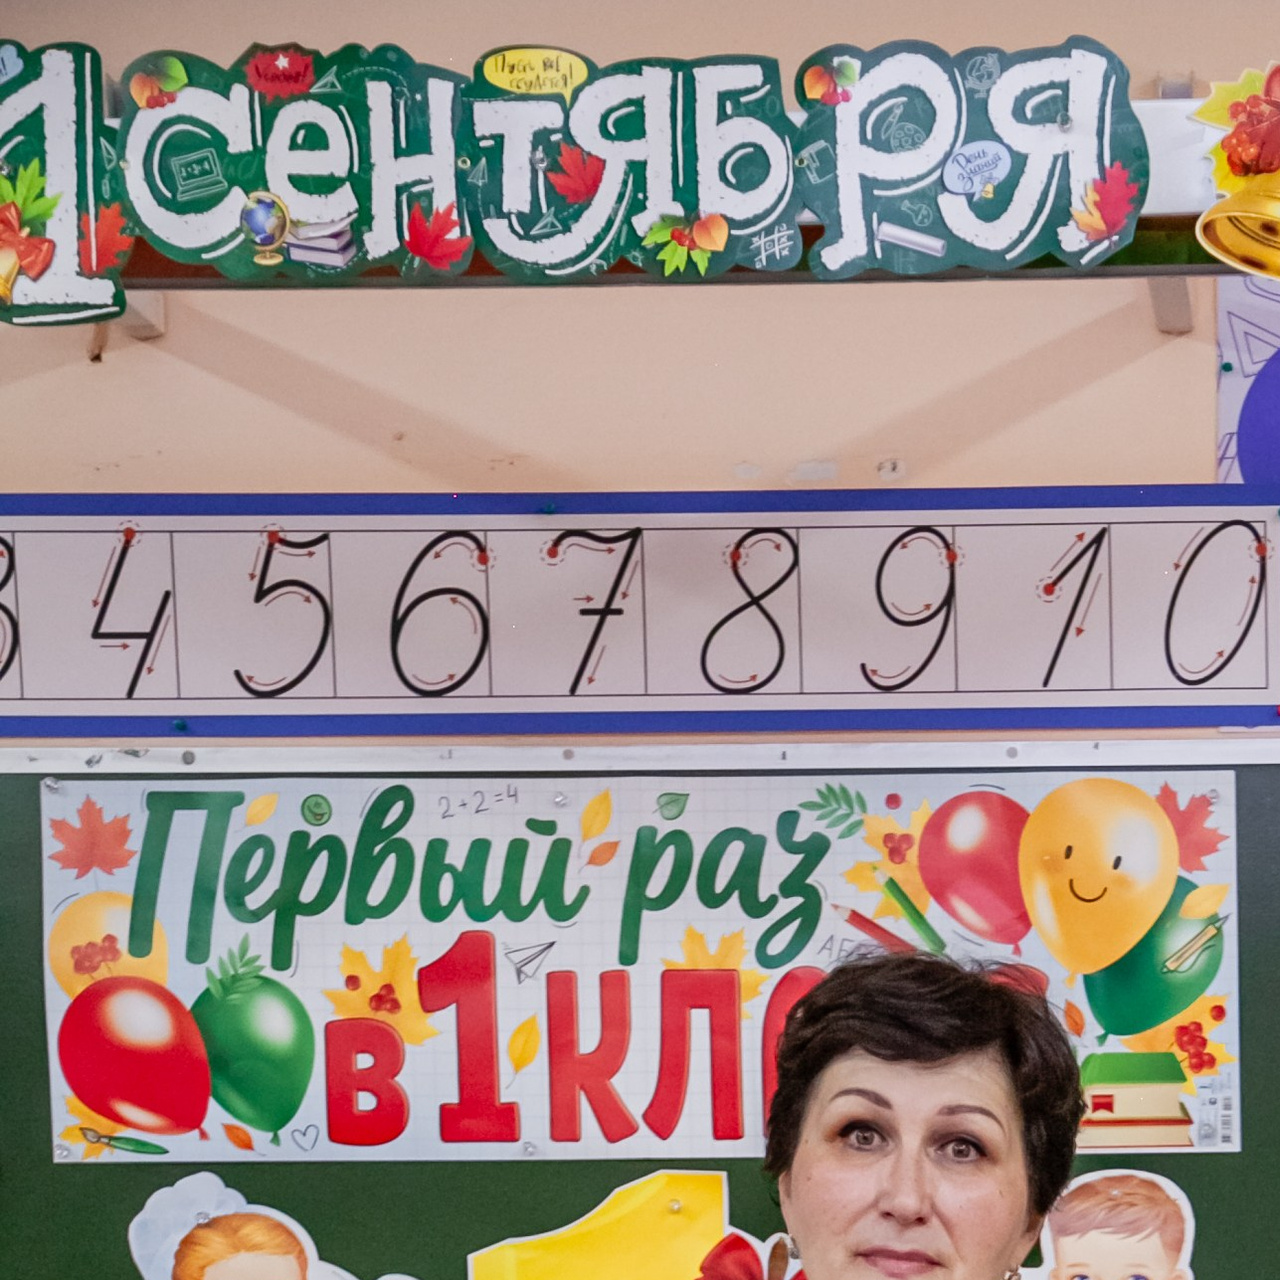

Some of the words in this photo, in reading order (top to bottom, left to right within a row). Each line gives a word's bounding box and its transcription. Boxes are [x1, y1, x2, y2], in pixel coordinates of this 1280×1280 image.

[91, 526, 173, 700] 4
[232, 526, 332, 699] 5
[389, 529, 491, 698] 6
[547, 526, 643, 696] 7
[700, 526, 800, 695] 8
[860, 525, 956, 692] 9
[127, 783, 592, 972] Первый
[618, 808, 832, 970] раз
[417, 930, 521, 1143] 1
